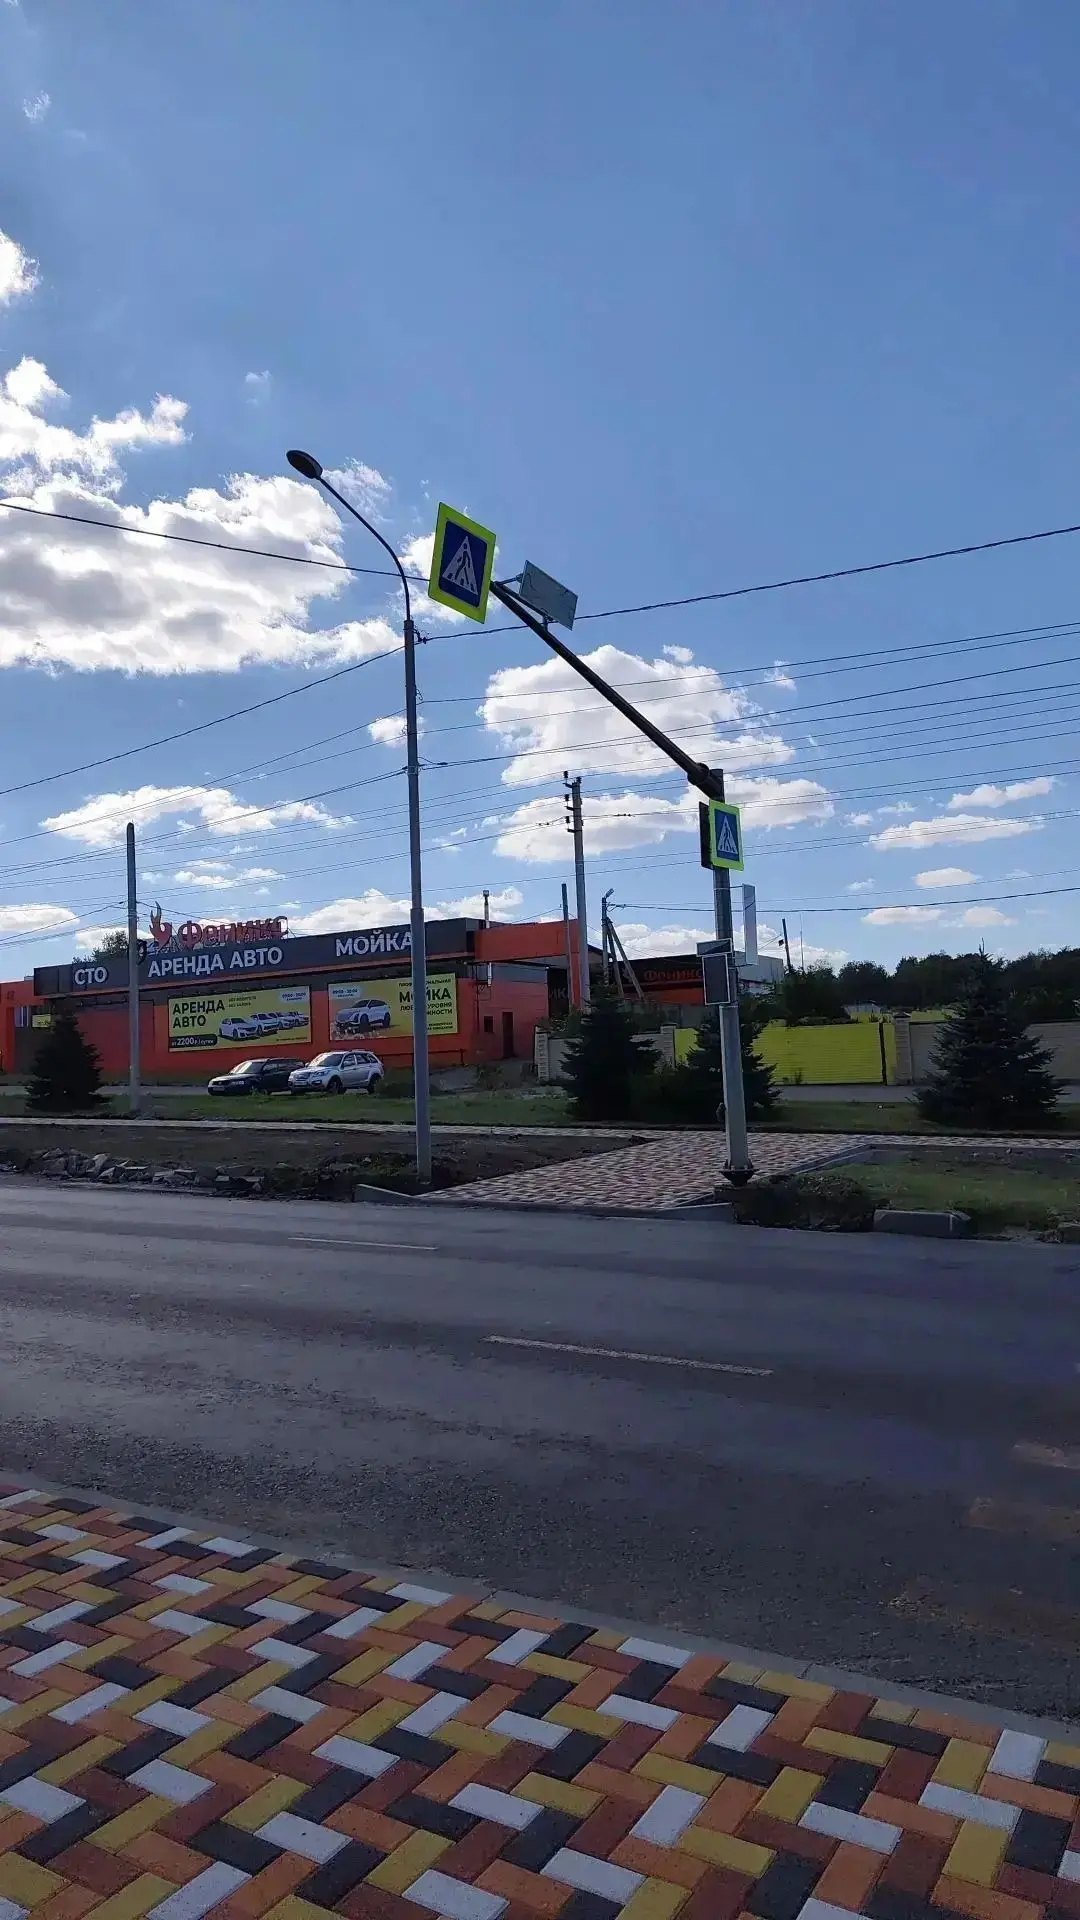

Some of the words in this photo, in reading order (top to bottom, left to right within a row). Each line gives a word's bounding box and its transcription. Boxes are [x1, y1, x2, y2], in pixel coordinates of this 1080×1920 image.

[177, 915, 288, 949] Феникс
[335, 929, 412, 957] МОЙКА
[147, 953, 225, 978] АРЕНДА
[229, 946, 283, 969] АВТО
[74, 966, 109, 986] СТО
[172, 999, 225, 1015] АРЕНДА
[172, 1015, 206, 1029] АВТО
